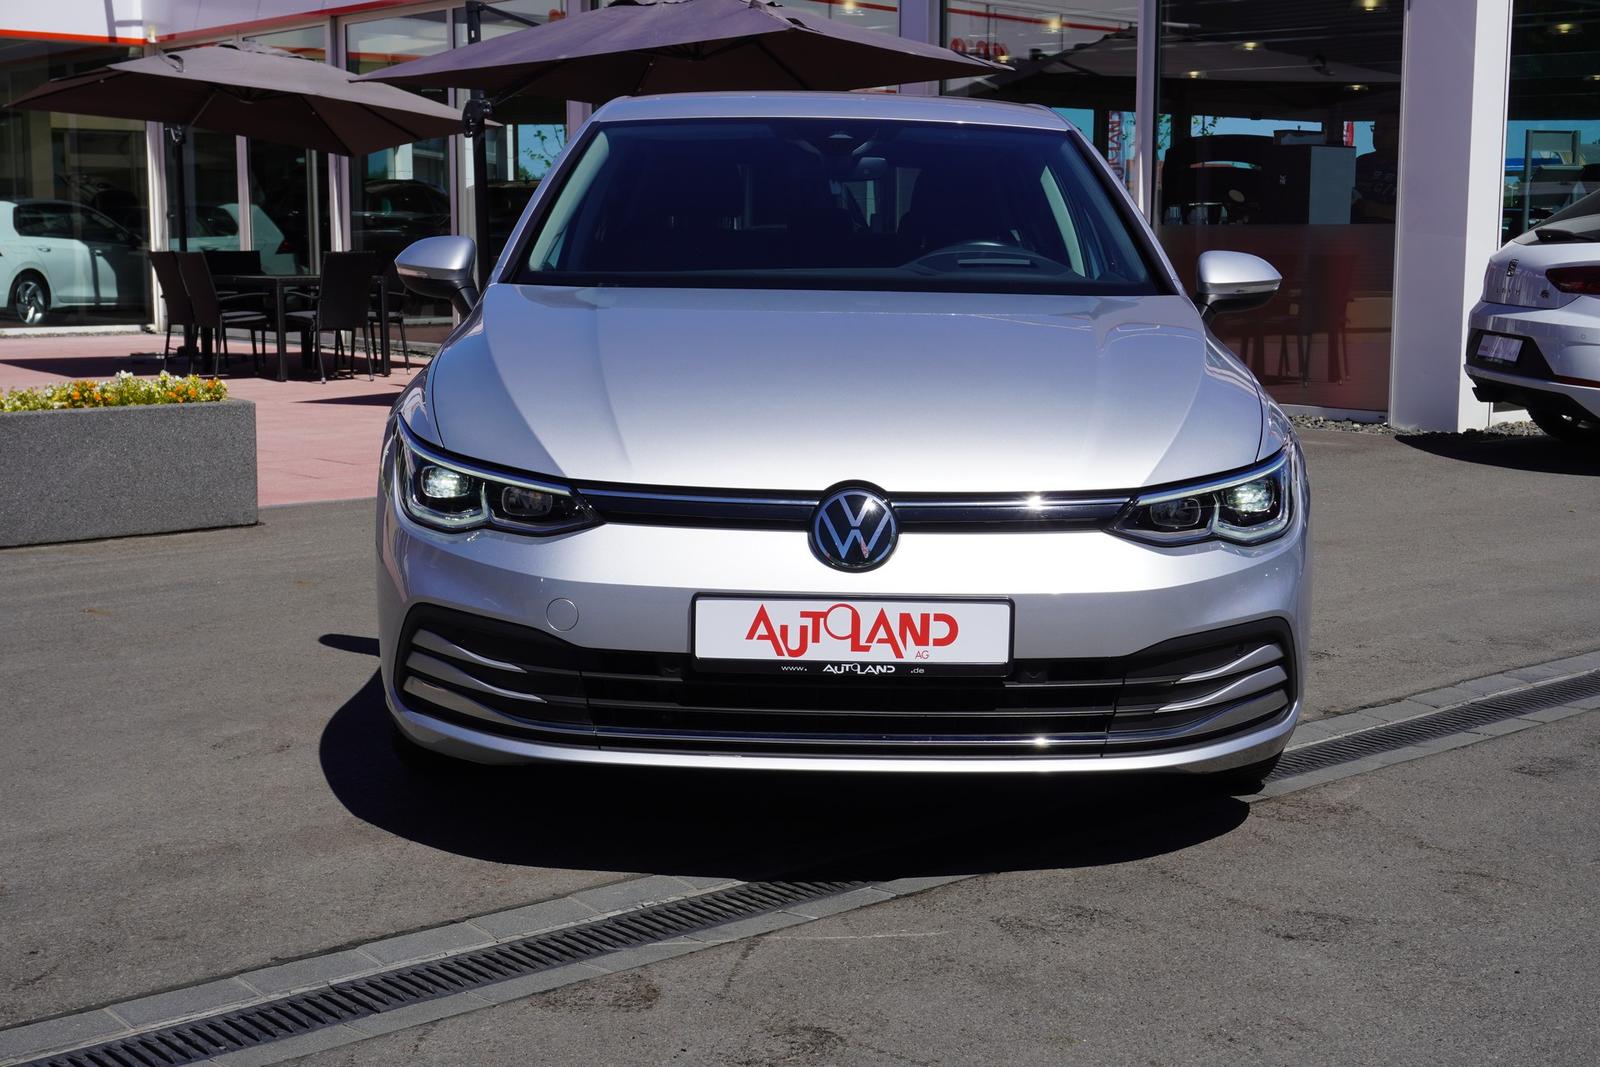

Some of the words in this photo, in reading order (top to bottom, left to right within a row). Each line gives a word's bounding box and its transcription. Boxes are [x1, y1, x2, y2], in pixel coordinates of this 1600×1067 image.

[745, 603, 959, 659] AUTOLAND
[914, 650, 929, 660] AG
[822, 663, 896, 675] AUTOLAND
